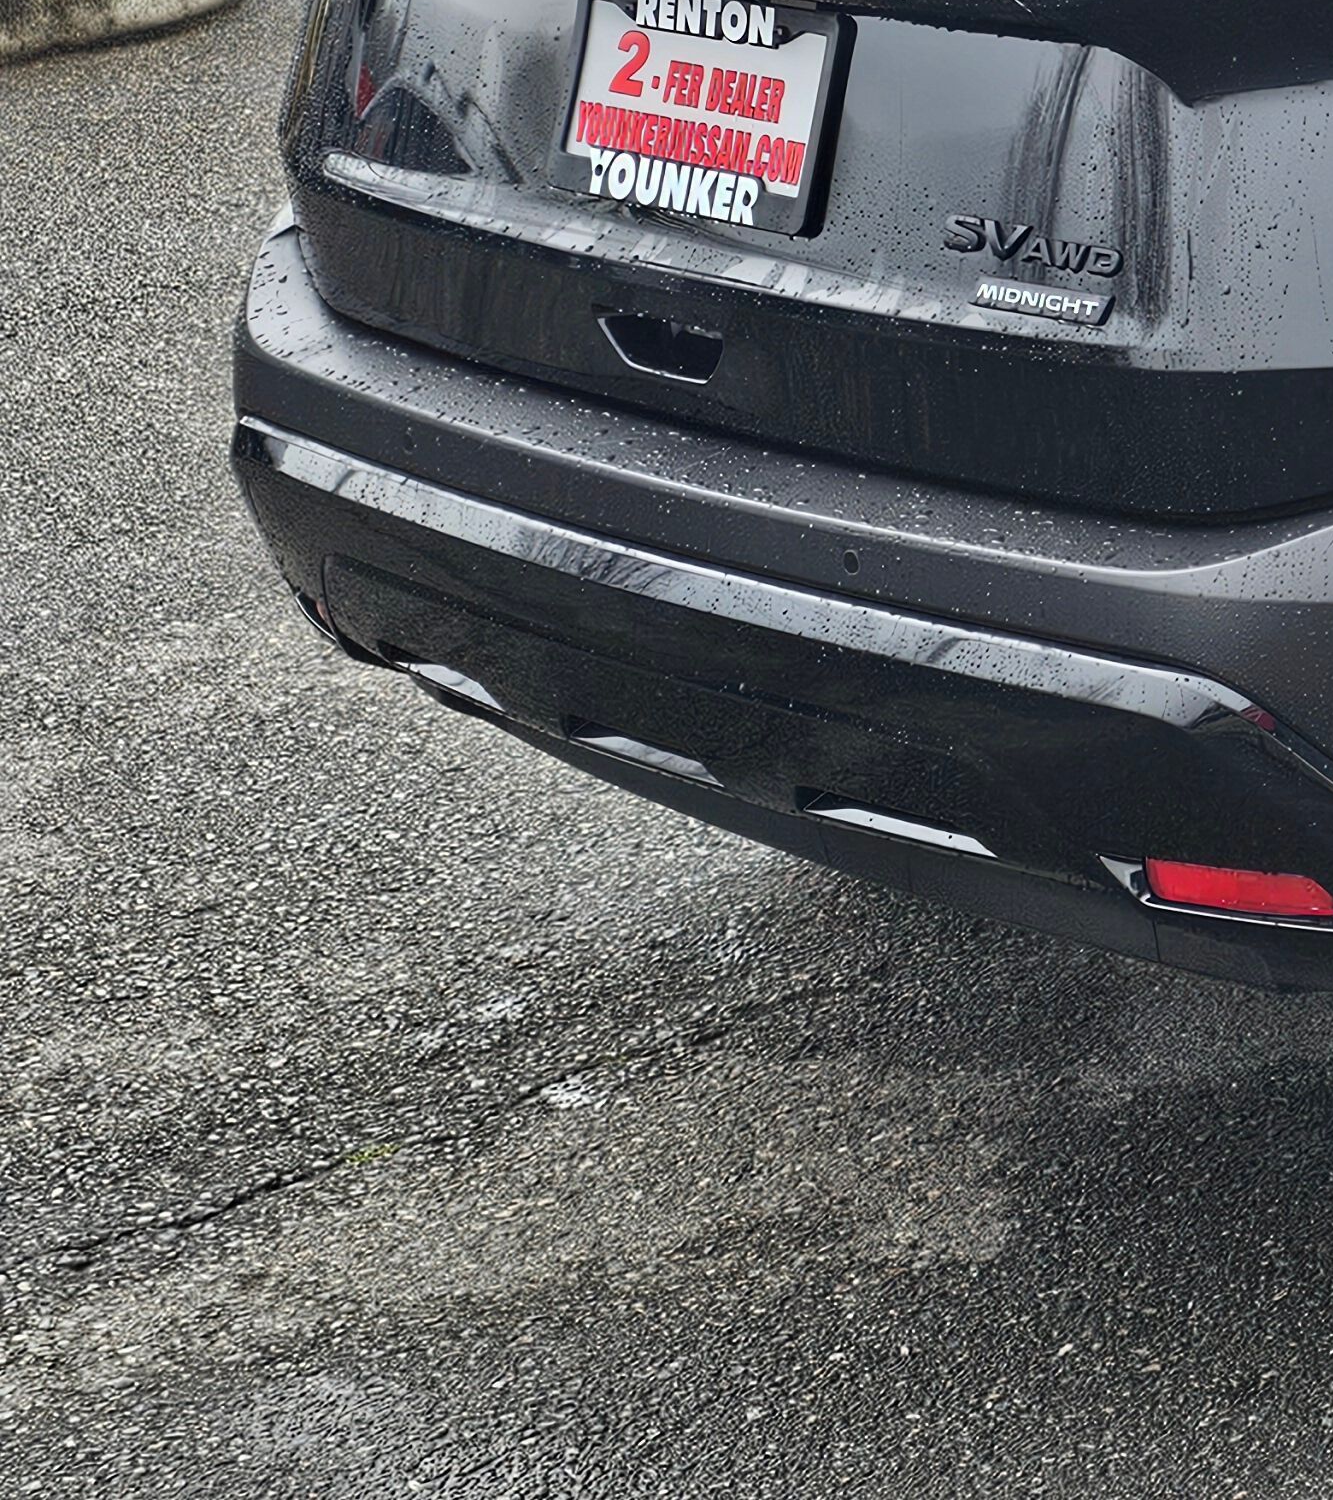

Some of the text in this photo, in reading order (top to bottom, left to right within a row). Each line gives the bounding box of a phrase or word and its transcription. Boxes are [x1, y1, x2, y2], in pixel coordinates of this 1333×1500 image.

[705, 66, 785, 124] DEALER
[575, 100, 806, 185] YOUNKERNISSAN.COM
[588, 146, 759, 226] YOUNKER
[1020, 236, 1125, 278] AWD
[976, 283, 1100, 316] MIDNIGHT
